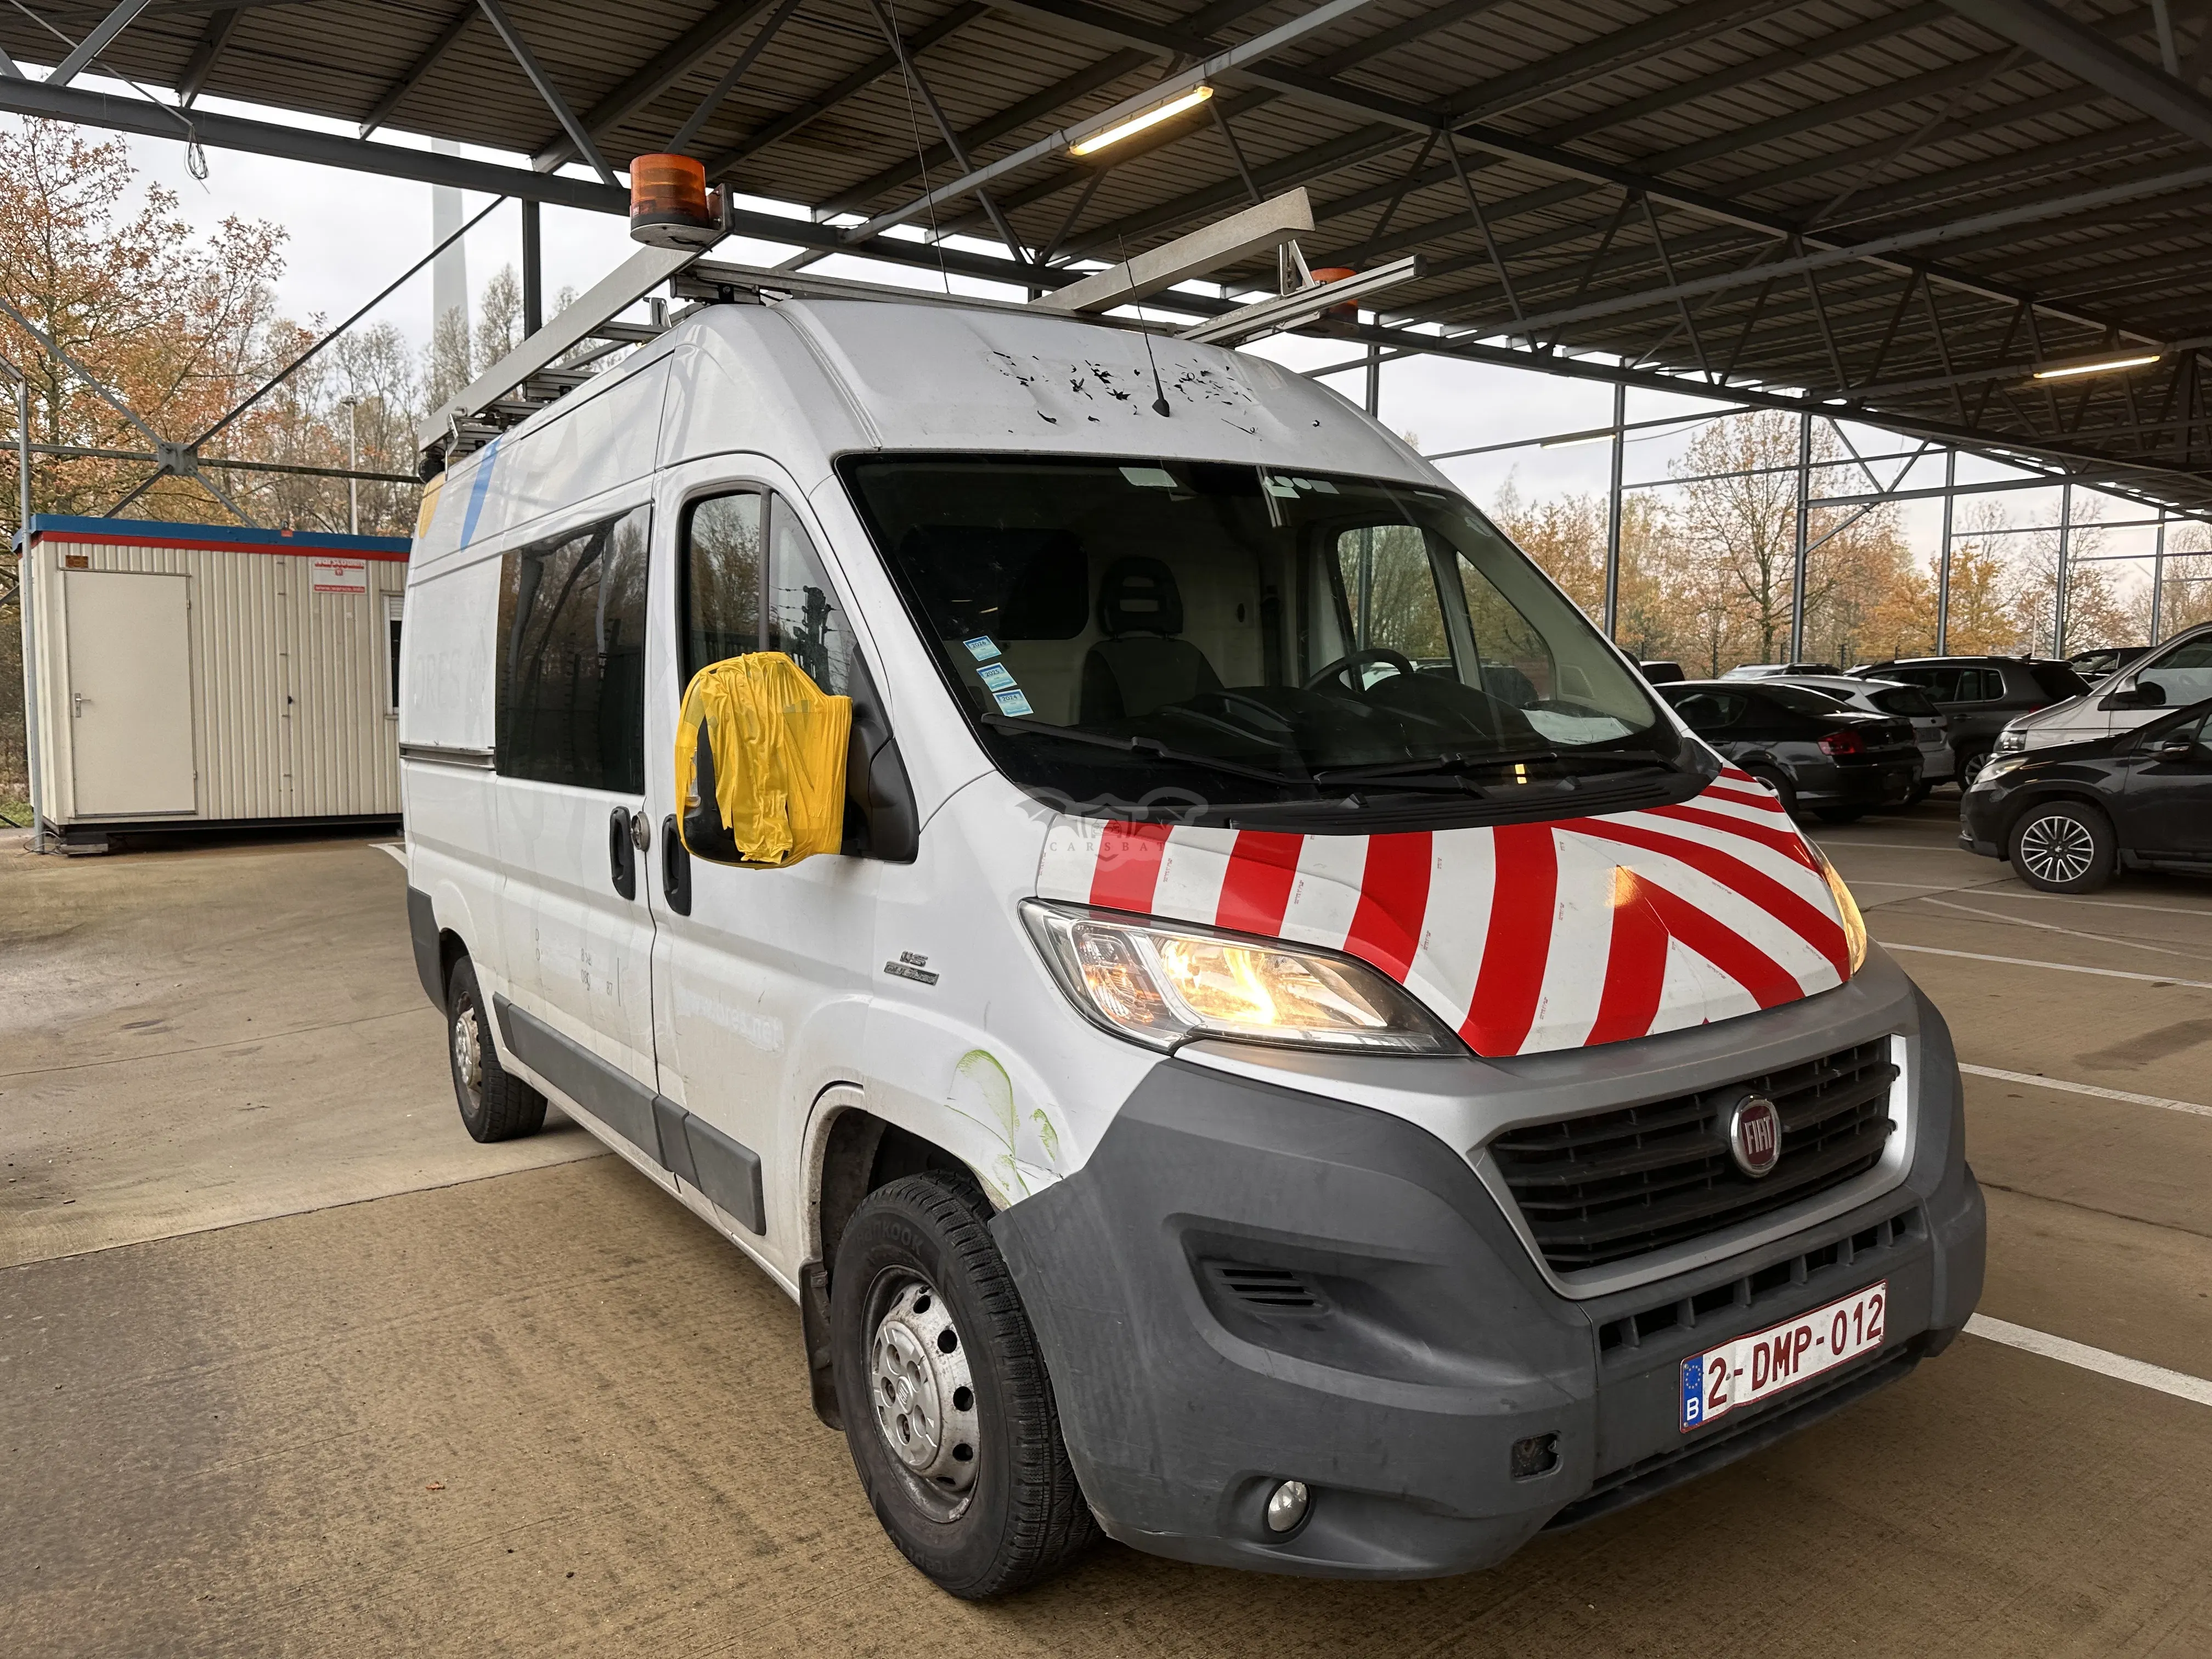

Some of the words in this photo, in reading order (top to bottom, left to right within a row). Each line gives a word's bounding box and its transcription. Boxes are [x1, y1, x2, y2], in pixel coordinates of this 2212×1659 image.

[1742, 1115, 1773, 1155] FIAT
[1686, 1397, 1700, 1421] B
[1708, 1294, 1883, 1409] 2-DMP-012
